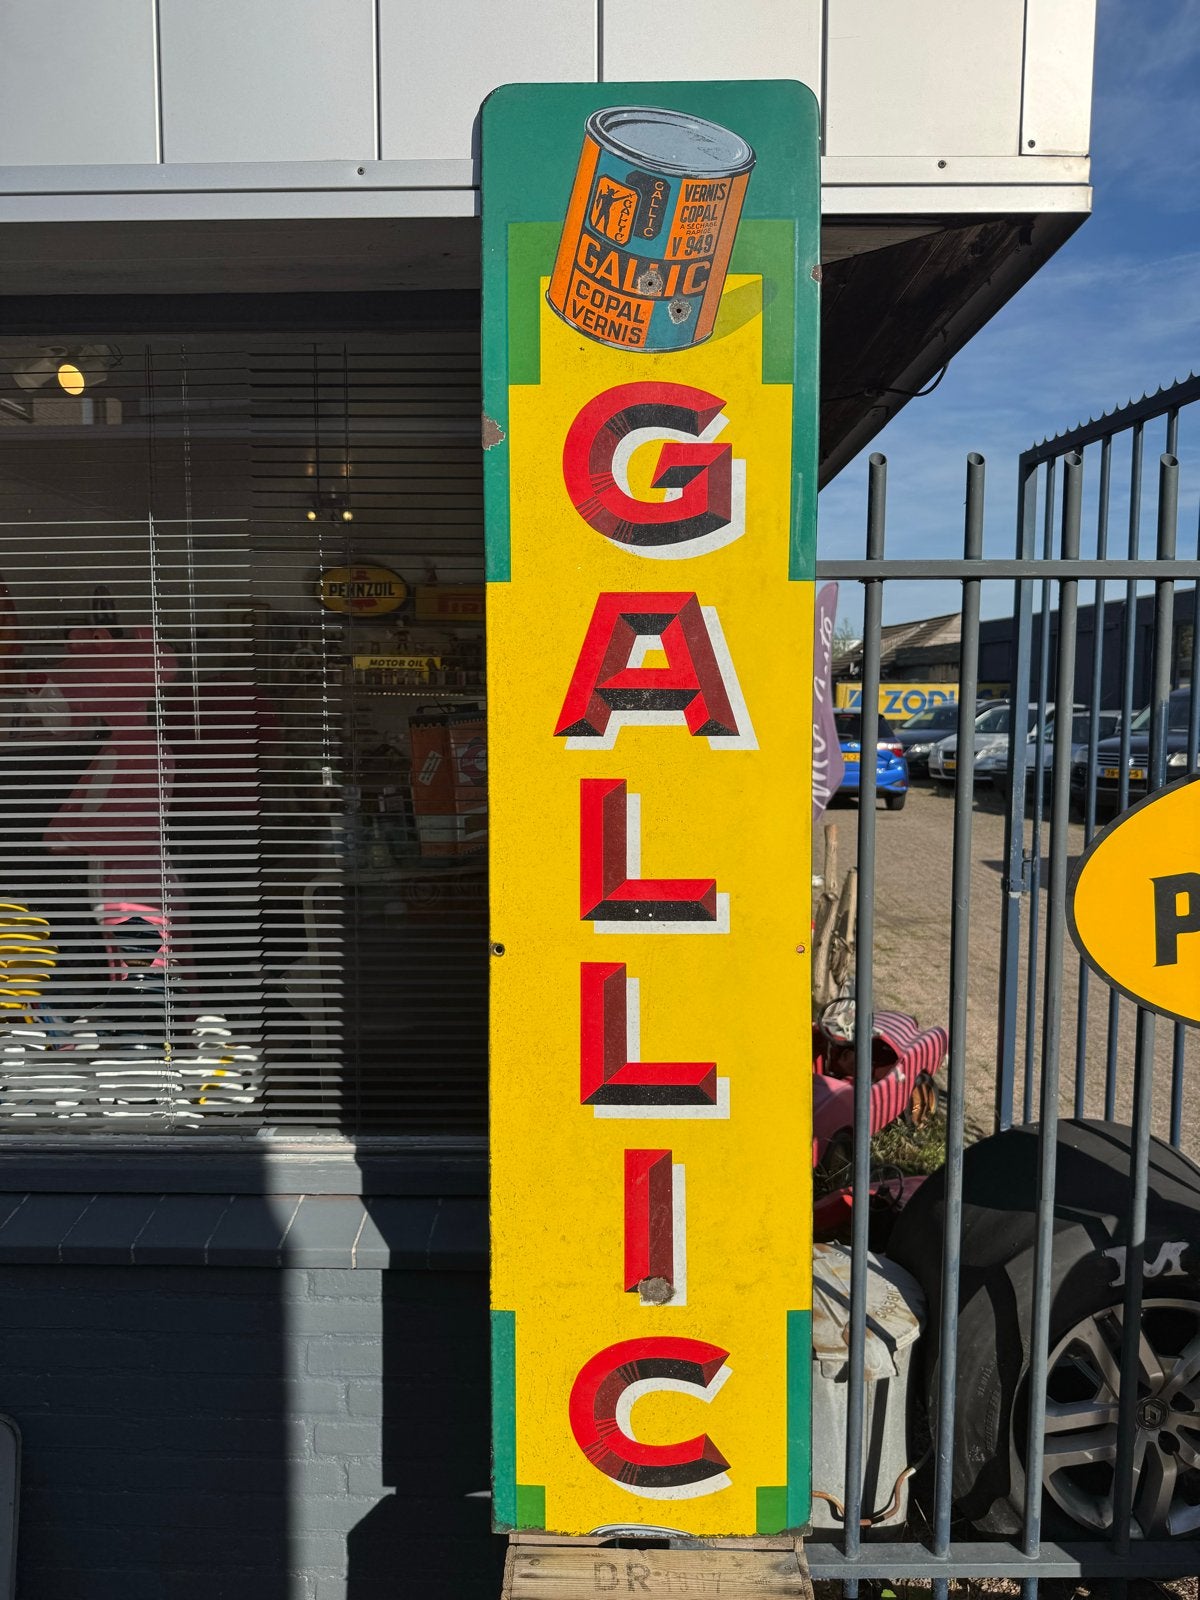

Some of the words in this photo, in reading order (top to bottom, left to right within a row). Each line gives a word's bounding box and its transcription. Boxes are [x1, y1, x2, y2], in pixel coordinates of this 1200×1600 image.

[684, 183, 727, 203] VERNIS
[643, 181, 665, 237] GALLIC
[680, 204, 718, 223] COPAL
[685, 228, 712, 236] RAPIDE
[671, 236, 683, 257] V
[684, 233, 714, 256] 949
[575, 279, 645, 325] COPAL
[571, 299, 643, 345] VERNIS
[328, 581, 396, 598] PENNZOIL
[369, 659, 407, 668] MOTOR
[407, 659, 424, 668] OIL
[554, 381, 759, 1501] GALLIC
